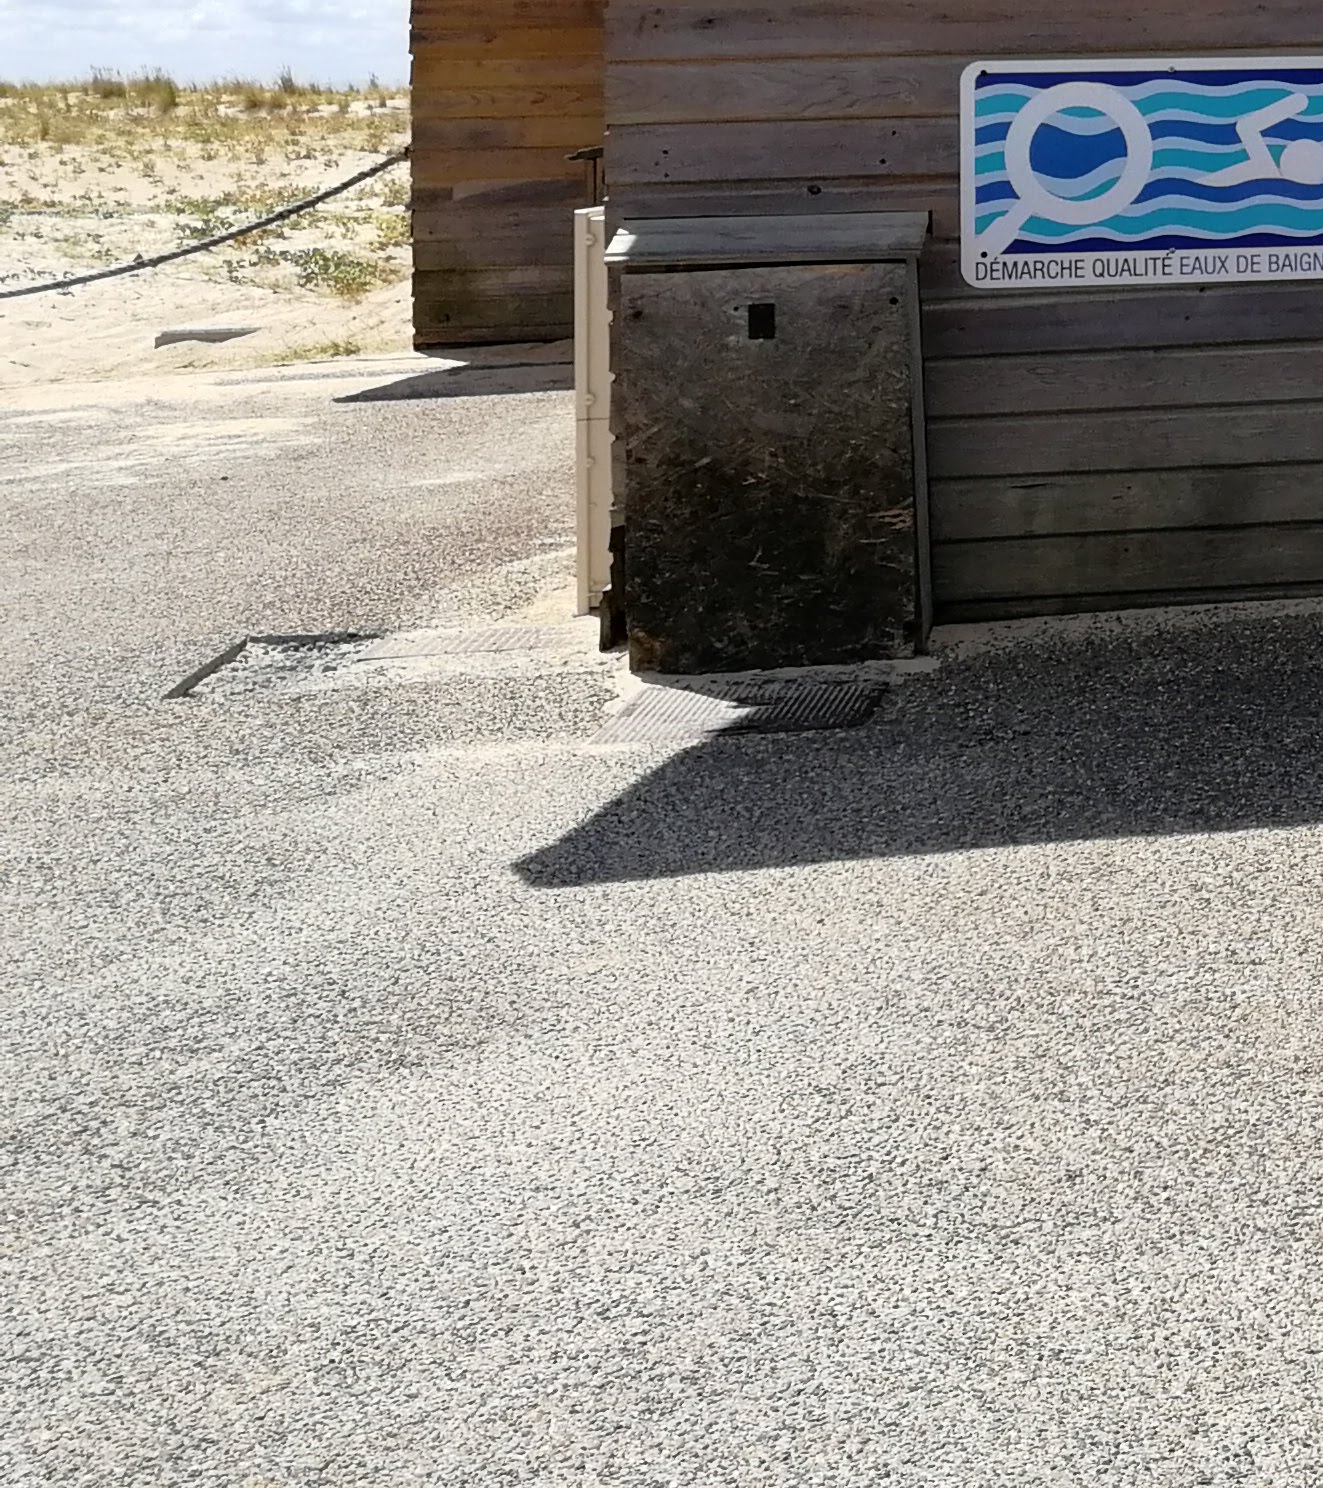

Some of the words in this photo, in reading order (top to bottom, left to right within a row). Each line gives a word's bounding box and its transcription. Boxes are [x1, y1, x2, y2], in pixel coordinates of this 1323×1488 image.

[975, 257, 1086, 281] DÉMARCHE
[1092, 251, 1173, 278] QUALITÉ
[1180, 255, 1228, 275] EAUX
[1236, 254, 1261, 274] DE
